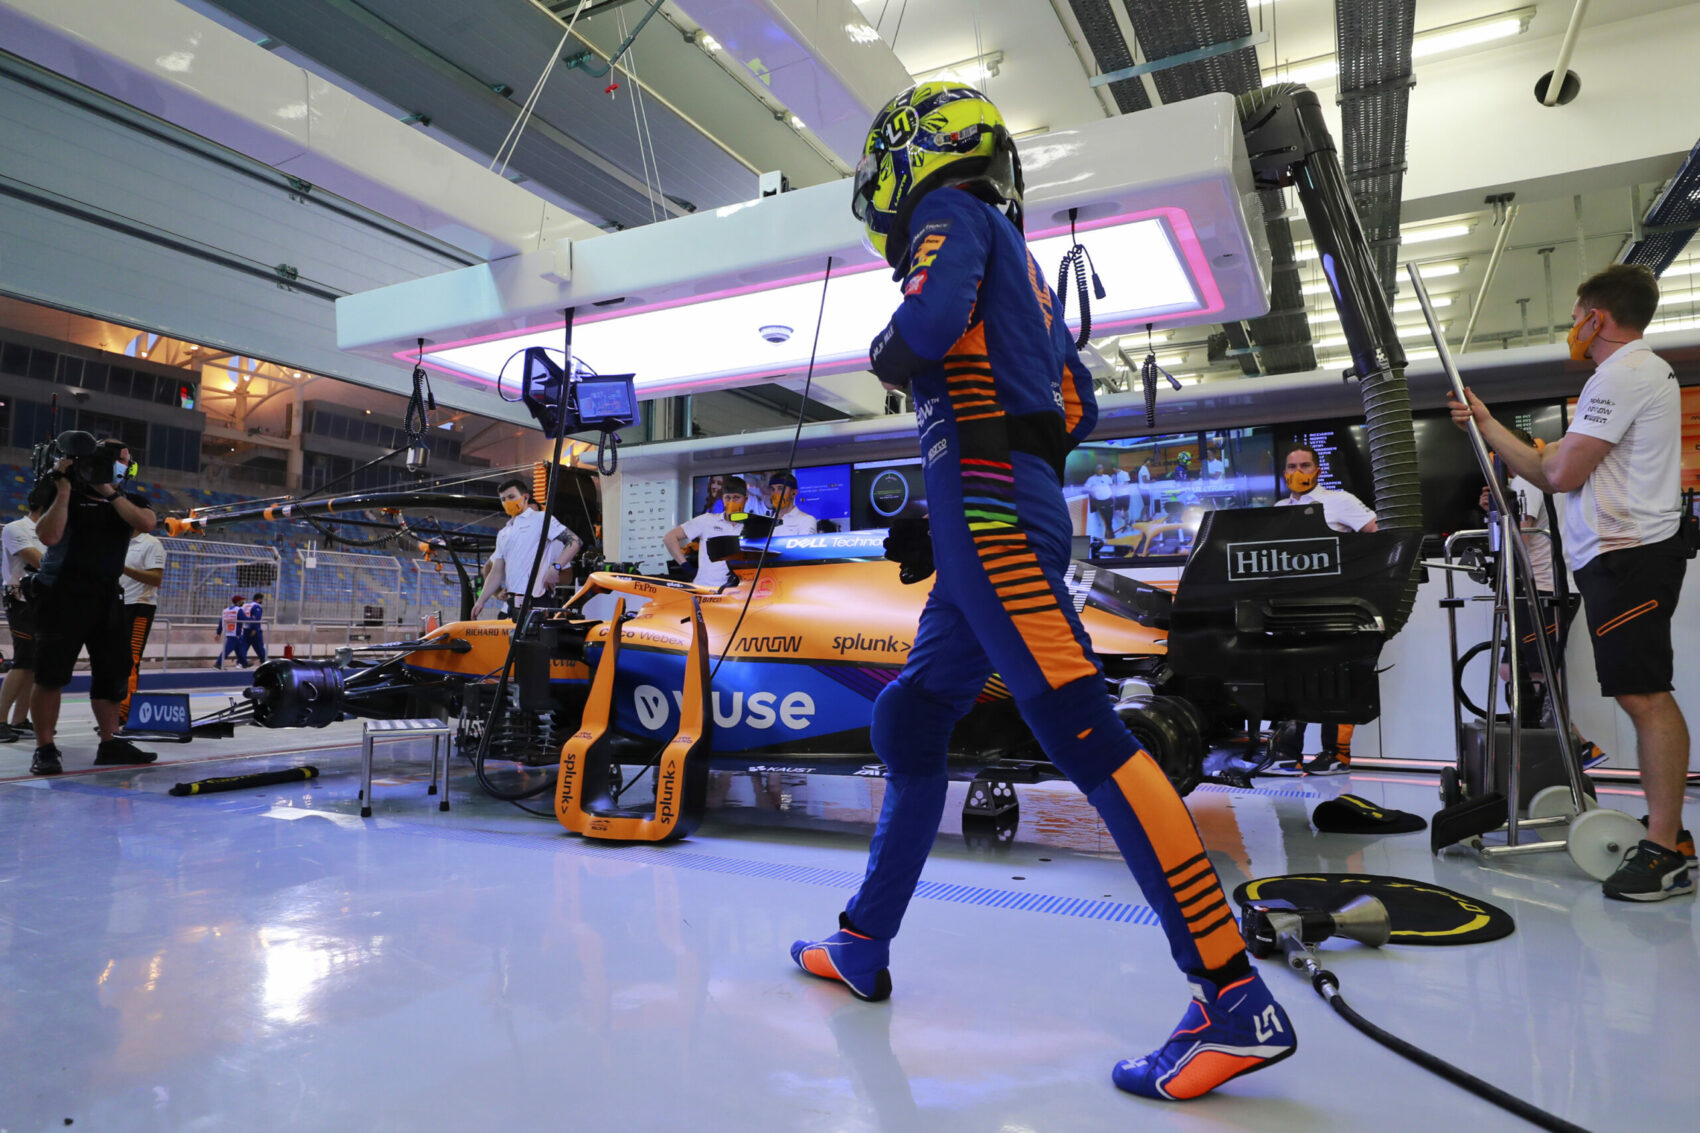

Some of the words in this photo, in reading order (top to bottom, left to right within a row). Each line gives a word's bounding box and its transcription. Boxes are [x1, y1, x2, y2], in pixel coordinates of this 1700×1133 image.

[785, 537, 828, 549] DELL
[1236, 549, 1330, 574] Hilton
[633, 581, 657, 594] FxPro
[465, 628, 499, 637] RICHARD
[600, 628, 635, 639] Cco
[640, 632, 684, 646] Webex
[734, 635, 802, 653] ARROW
[672, 690, 816, 730] use
